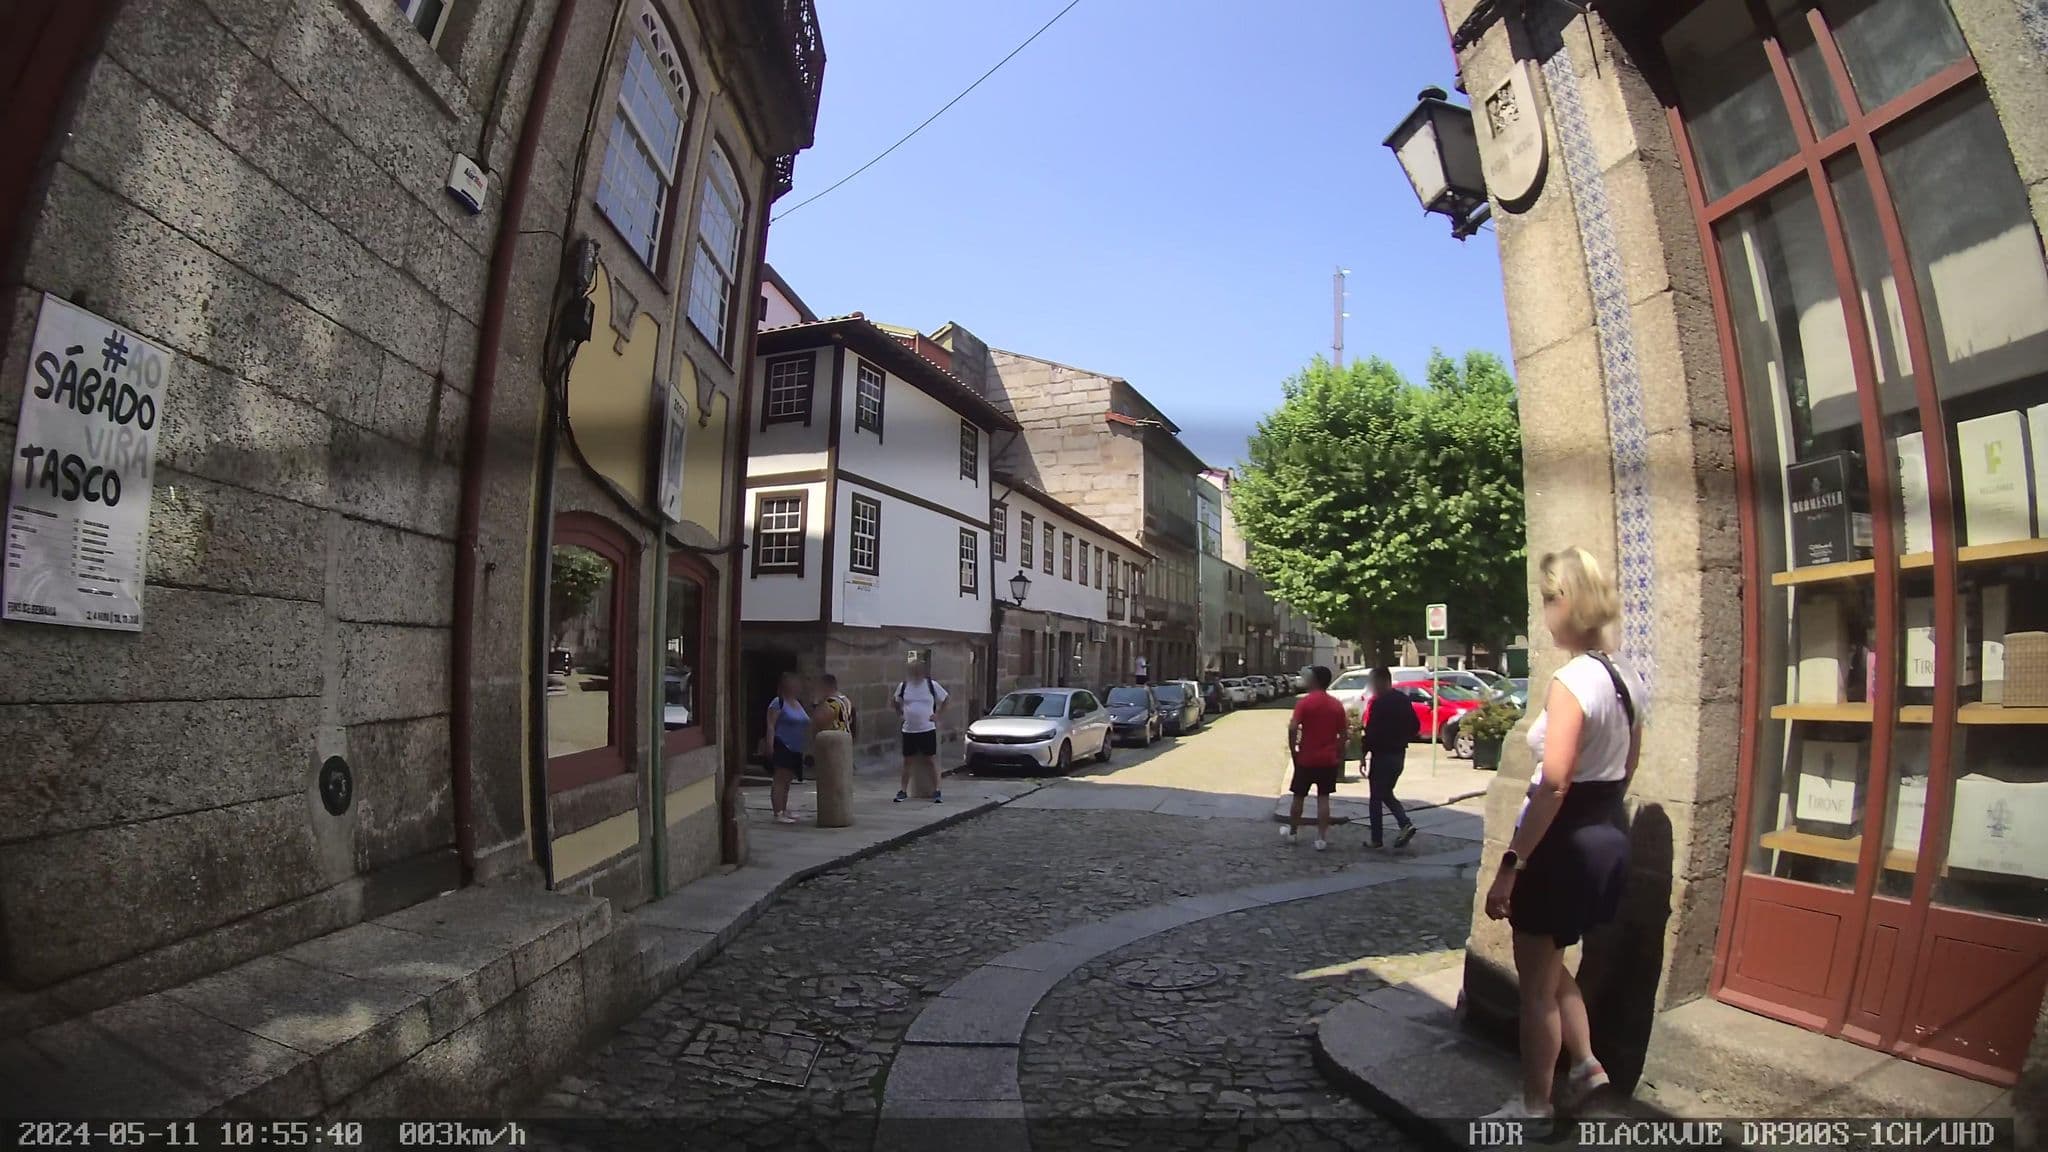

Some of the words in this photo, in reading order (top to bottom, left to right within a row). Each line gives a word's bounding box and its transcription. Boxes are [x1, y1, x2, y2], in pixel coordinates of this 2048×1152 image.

[34, 345, 155, 431] SÁBADO
[21, 444, 121, 506] TASCO
[85, 425, 148, 479] VIRA
[1808, 794, 1847, 813] TIRONE
